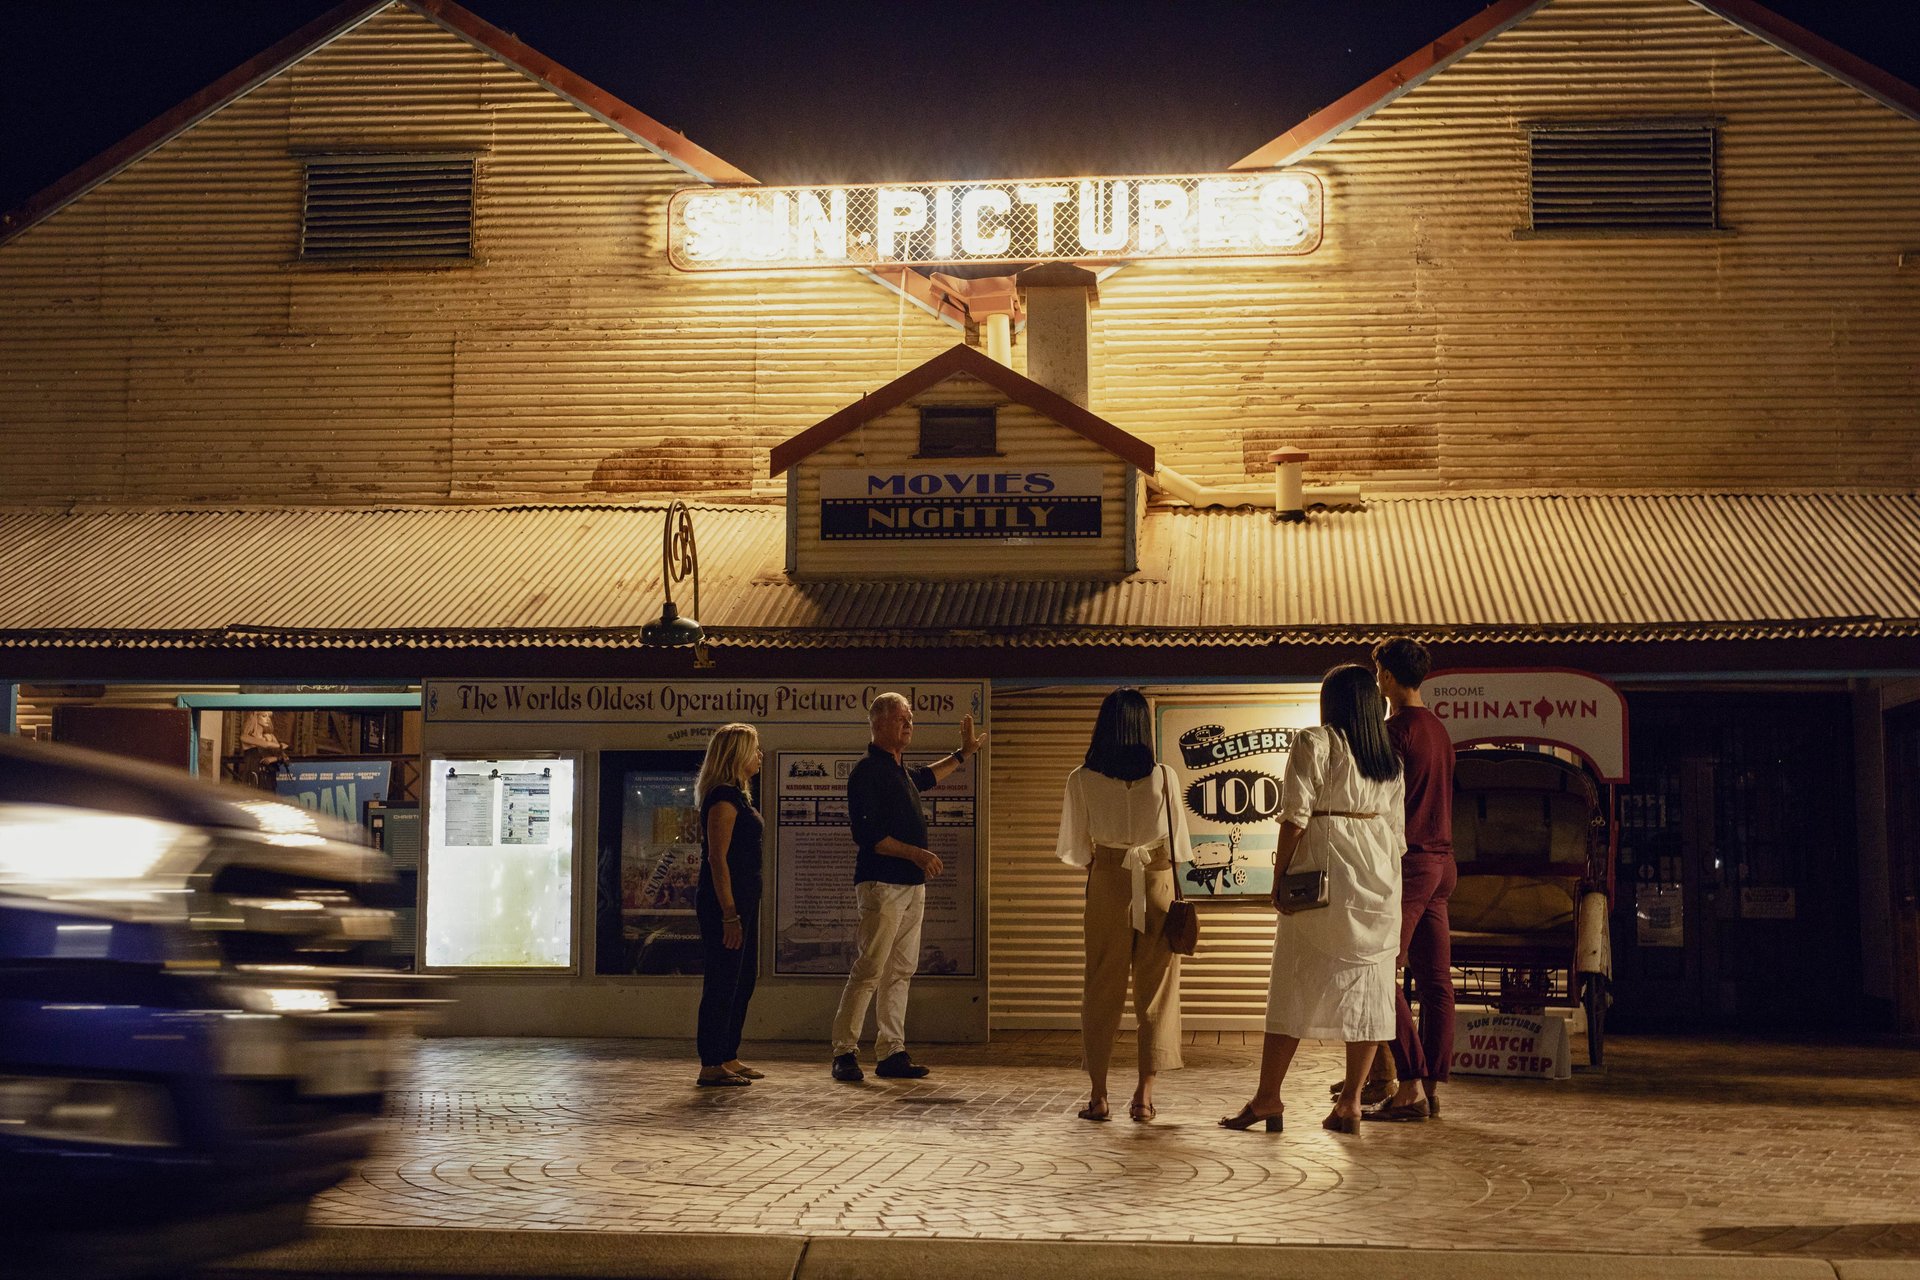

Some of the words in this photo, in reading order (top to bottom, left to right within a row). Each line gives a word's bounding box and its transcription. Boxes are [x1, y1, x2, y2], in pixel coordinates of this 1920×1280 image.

[878, 179, 1310, 258] PICTURES
[868, 472, 1055, 495] MOVIES
[867, 506, 1055, 528] NIGHTLY
[457, 685, 498, 714] The
[504, 686, 582, 710] Worlds
[587, 685, 655, 710] Oldest
[660, 686, 769, 717] Operating
[775, 686, 857, 711] Picture
[861, 686, 954, 713] Gdens
[1434, 687, 1485, 696] BROOME
[690, 728, 716, 736] PICT
[1211, 732, 1292, 759] CELEBR
[1196, 777, 1279, 815] 100
[645, 849, 677, 897] SUNDAY
[1467, 1017, 1490, 1030] SUN
[1491, 1016, 1543, 1034] PICTURES
[1469, 1035, 1535, 1053] WATCH
[1507, 1055, 1553, 1073] STEP
